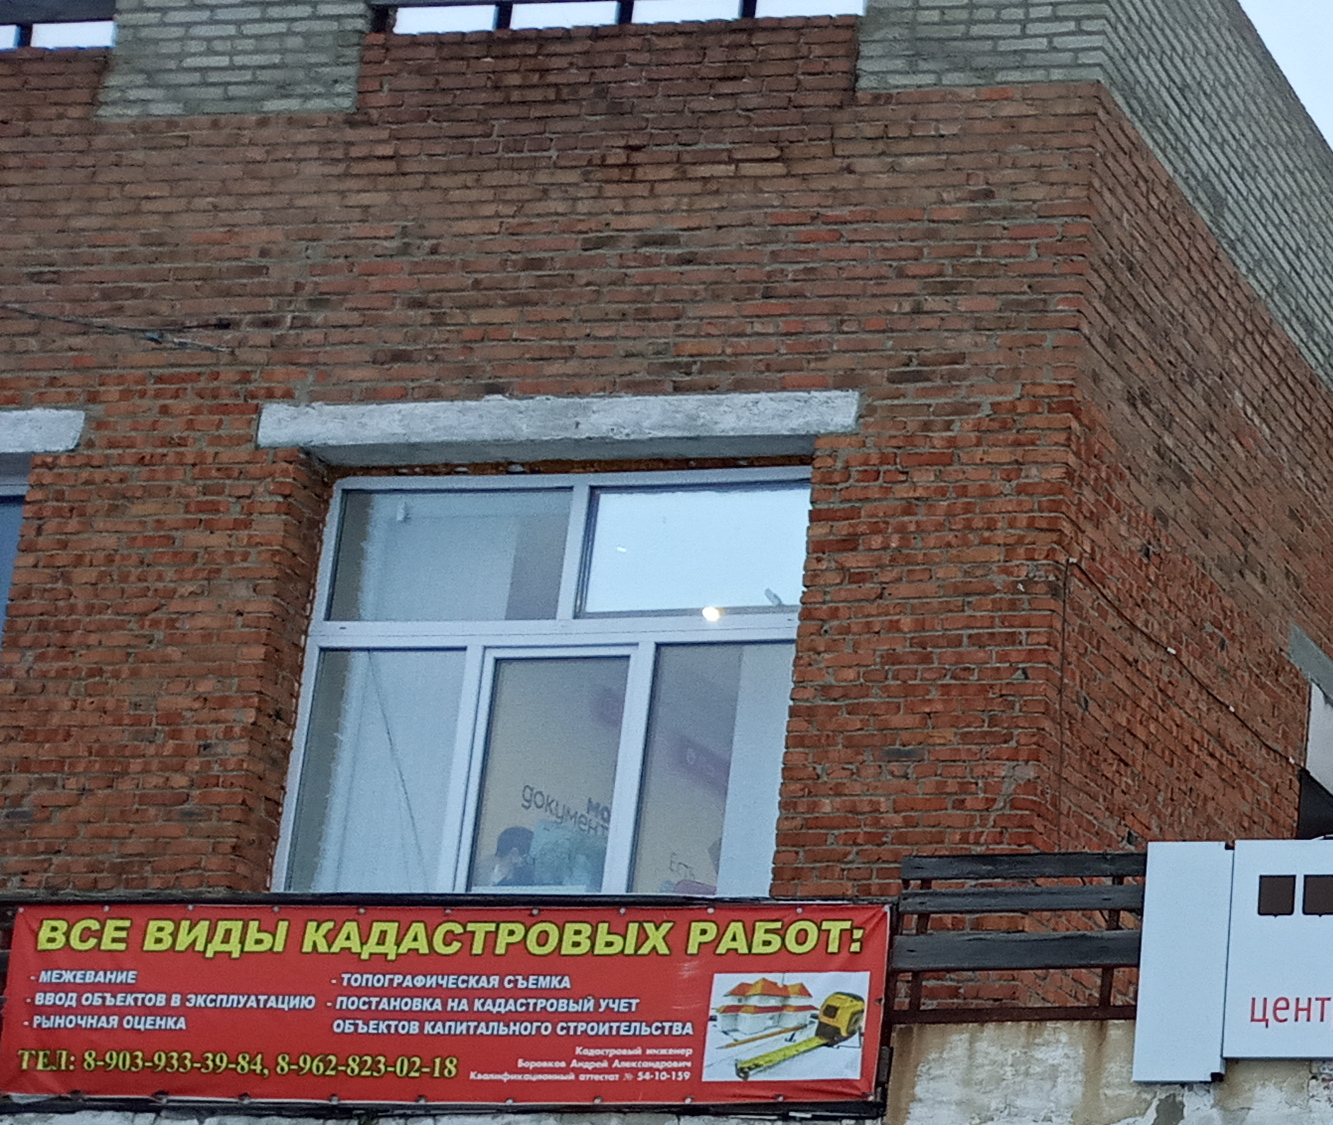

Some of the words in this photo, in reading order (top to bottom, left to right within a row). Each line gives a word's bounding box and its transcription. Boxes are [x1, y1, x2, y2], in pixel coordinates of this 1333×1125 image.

[521, 784, 610, 836] документ
[36, 918, 131, 953] ВСЕ
[142, 919, 290, 960] ВИДЫ
[301, 919, 675, 960] КАДАСТРОВЫХ
[686, 919, 866, 956] РАБОТ:
[38, 969, 138, 985] МЕЖЕВАНИЕ
[340, 973, 500, 989] ТОПОГРАФИЧЕСКАЯ
[503, 974, 572, 990] СЪЕМКА
[35, 992, 78, 1009] ВВОД
[81, 992, 167, 1008] ОБЪЕКТОВ
[171, 993, 182, 1008] В
[186, 993, 317, 1011] ЭКСПЛУАТАЦИЮ
[335, 996, 443, 1012] ПОСТАНОВКА
[446, 997, 469, 1012] НА
[473, 997, 595, 1014] КАДАСТРОВЫЙ
[598, 999, 640, 1013] УЧЕТ
[33, 1015, 118, 1031] РЫНОЧНАЯ
[123, 1016, 187, 1032] ОЦЕНКА
[333, 1019, 420, 1035] ОБЪЕКТОВ
[424, 1020, 553, 1036] КАПИТАЛЬНОГО
[556, 1021, 694, 1037] СТРОИТЕЛЬСТВА
[18, 1049, 76, 1071] ТЕЛ:
[83, 1049, 270, 1077] 8-903-933-39-84,
[275, 1053, 459, 1079] 8-962-823-02-18
